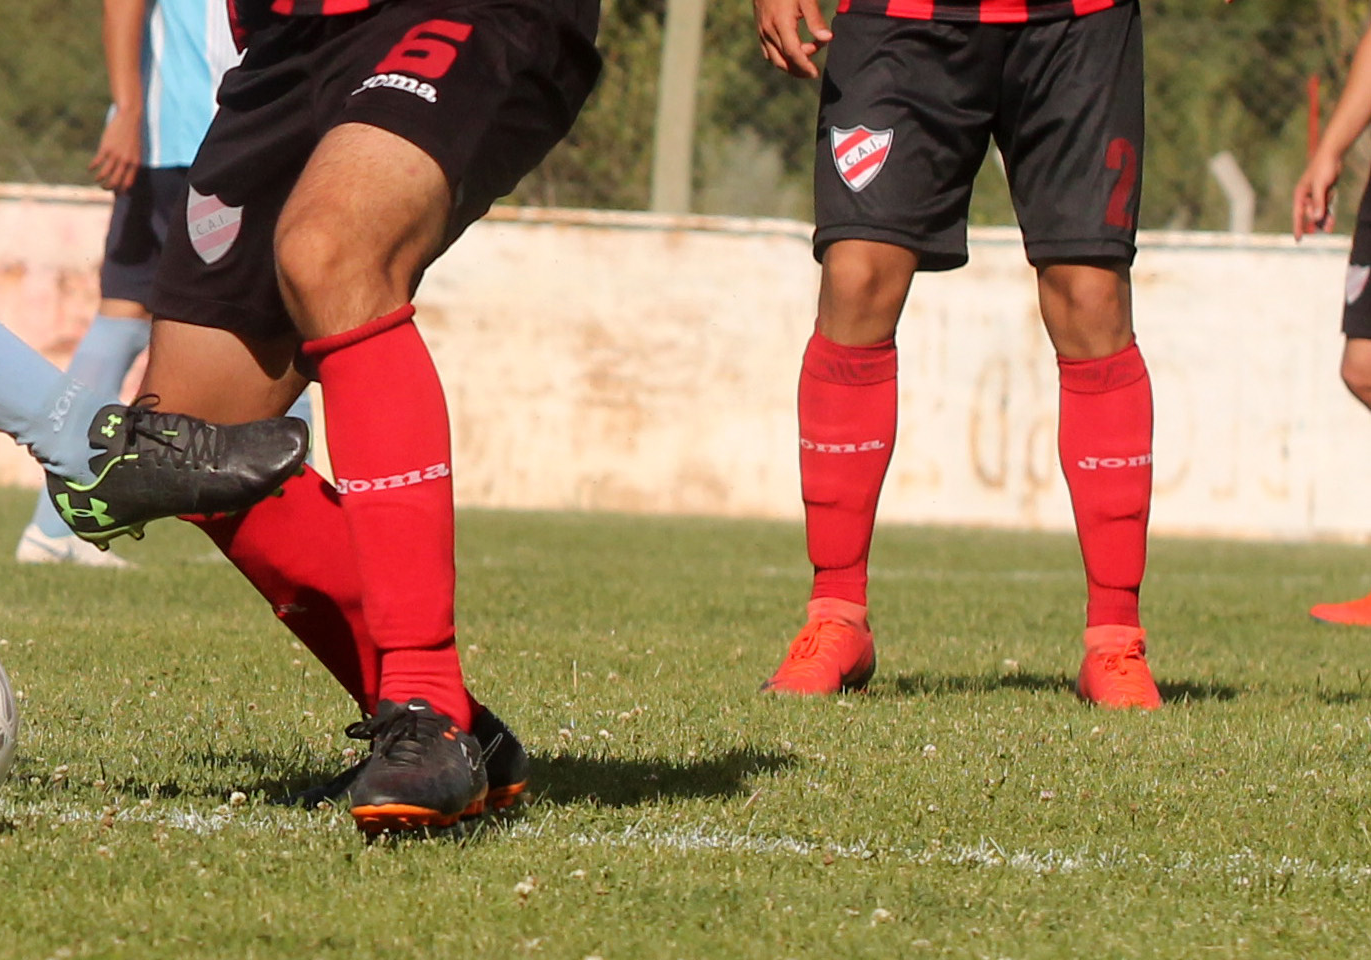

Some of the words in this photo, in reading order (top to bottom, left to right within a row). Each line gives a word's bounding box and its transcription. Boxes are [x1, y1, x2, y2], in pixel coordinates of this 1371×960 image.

[374, 19, 474, 79] 6
[844, 139, 882, 166] C.A.I.
[1104, 137, 1137, 230] 2
[800, 438, 885, 454] oma
[1077, 452, 1152, 471] Jom
[335, 463, 449, 495] Joma
